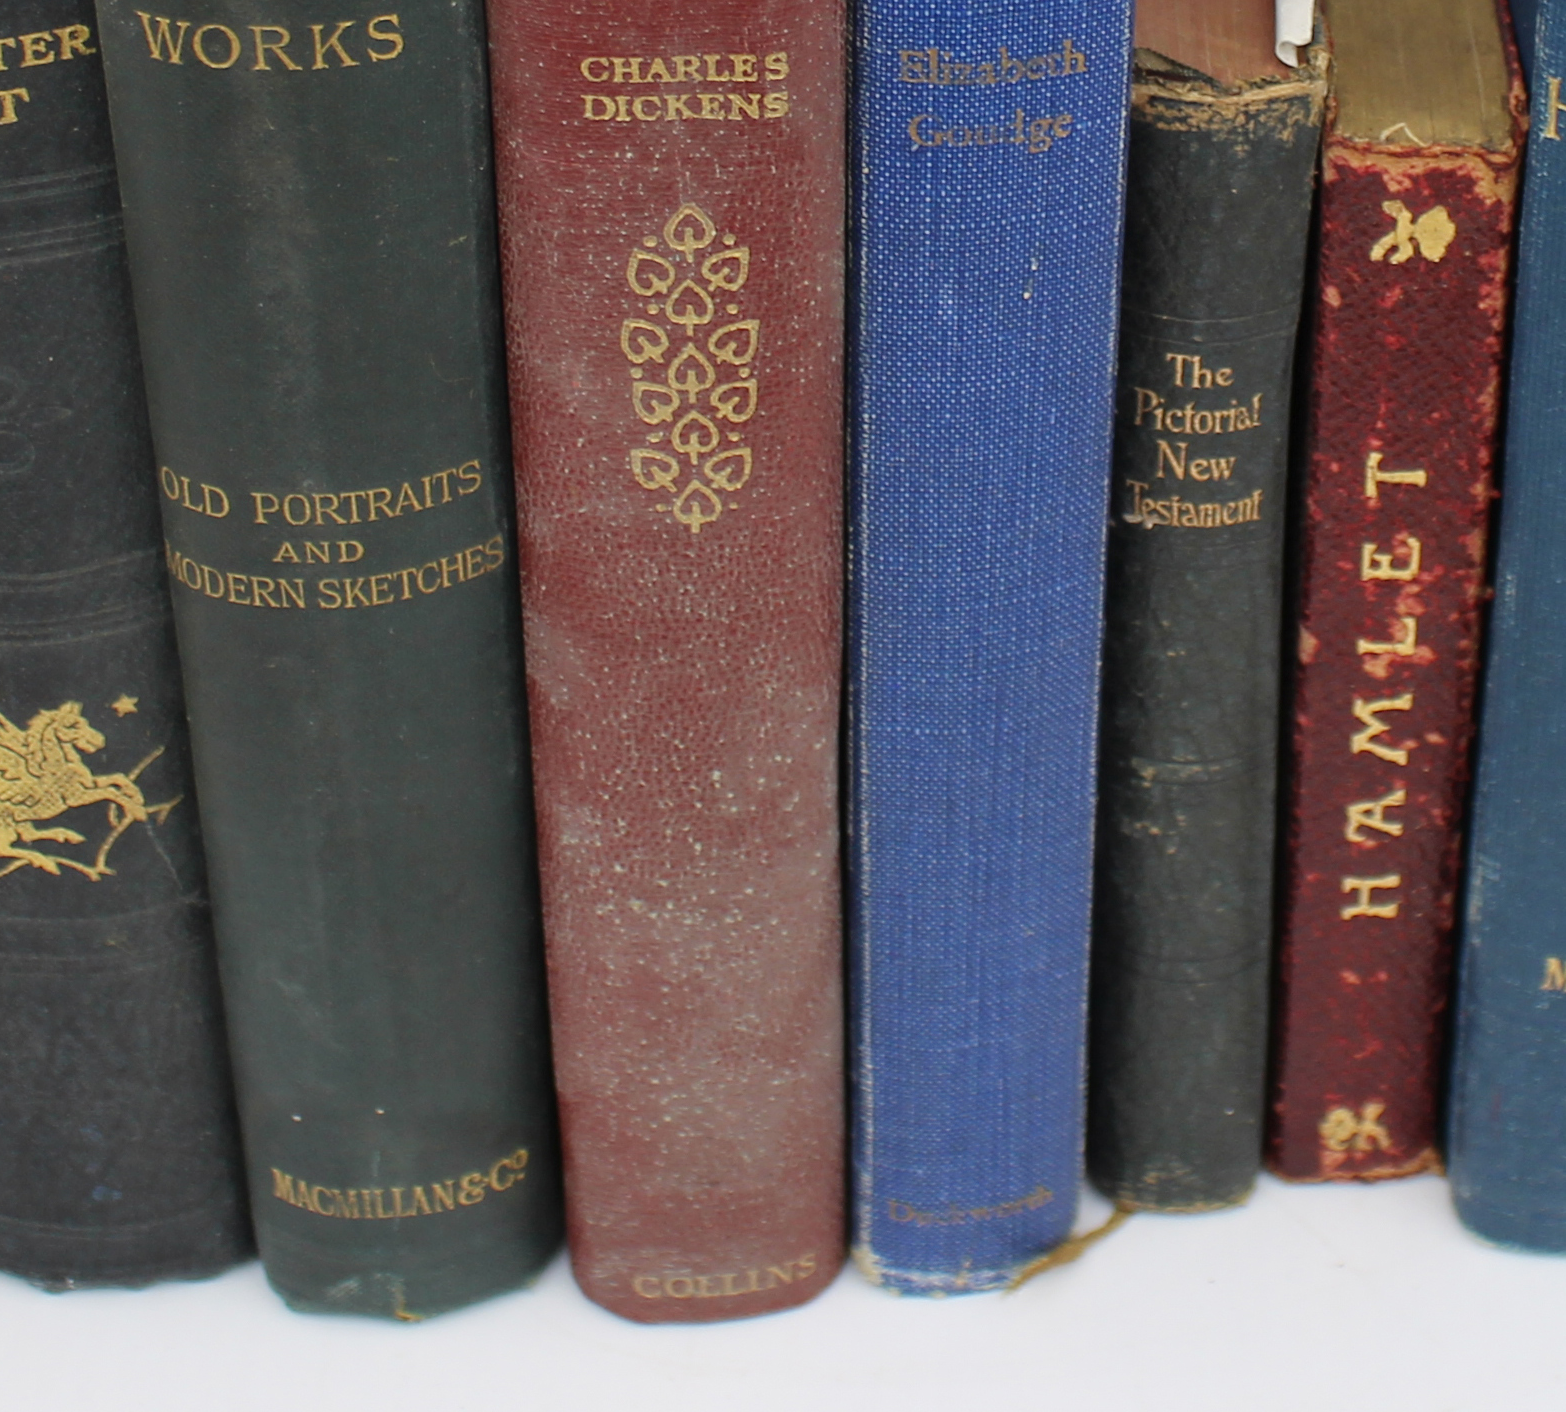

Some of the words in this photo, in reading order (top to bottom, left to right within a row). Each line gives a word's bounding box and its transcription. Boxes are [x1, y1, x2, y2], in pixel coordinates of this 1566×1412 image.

[135, 13, 405, 72] WORKS
[897, 39, 1088, 86] Elizabeth
[580, 52, 790, 84] CHARLES
[580, 92, 790, 122] DICKENS
[907, 109, 1074, 154] Goudge
[1165, 353, 1235, 389] The
[1134, 386, 1263, 435] Pictorial
[1156, 439, 1237, 482] New
[160, 466, 230, 519] OLD
[250, 459, 483, 526] PORTRAITS
[1125, 478, 1264, 529] Testament
[164, 538, 306, 609] MODERN
[318, 534, 505, 609] SKETCHES
[272, 540, 365, 564] AND
[1340, 451, 1428, 921] HAMLET
[632, 1253, 817, 1299] COLLINS
